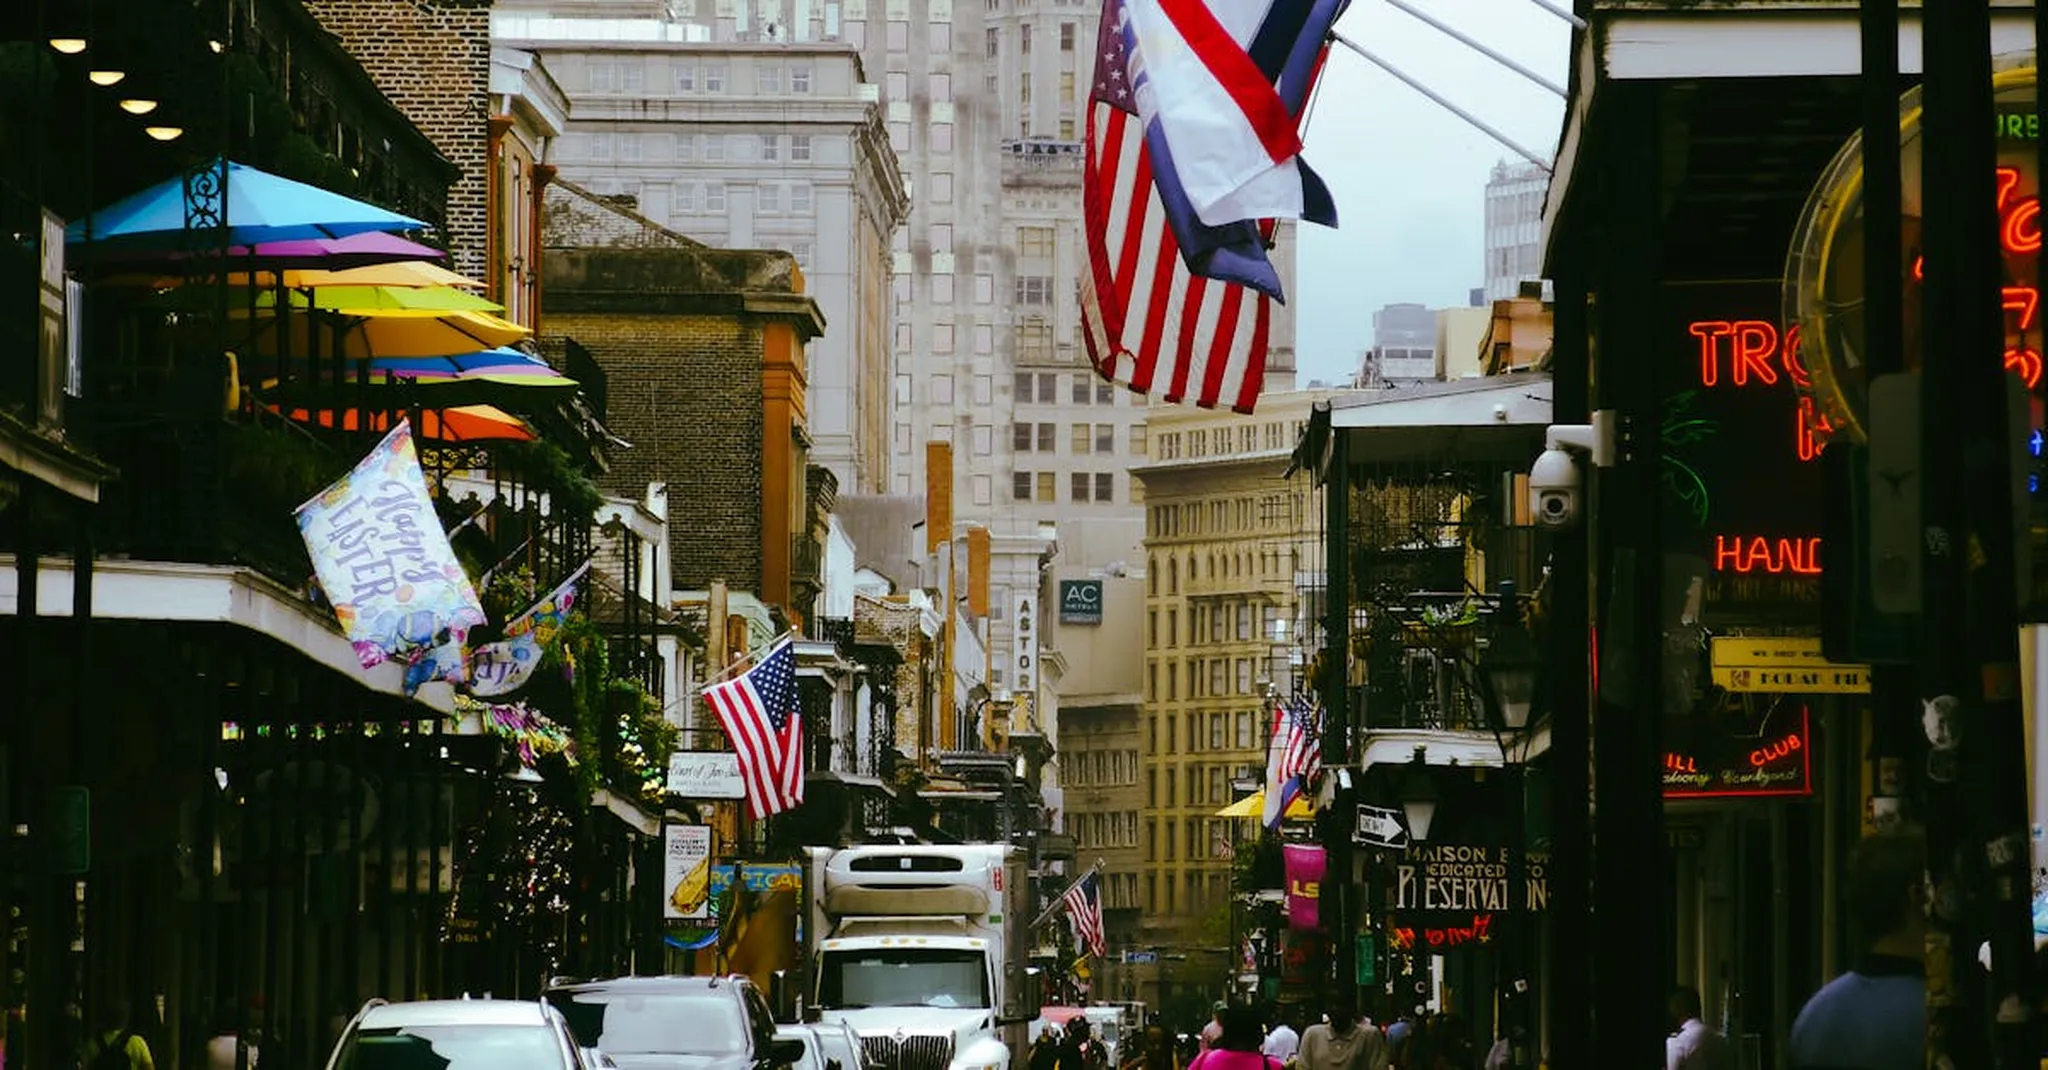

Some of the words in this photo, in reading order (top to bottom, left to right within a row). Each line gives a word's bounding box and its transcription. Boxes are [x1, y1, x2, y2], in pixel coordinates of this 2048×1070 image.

[371, 480, 450, 589] Happy
[327, 495, 398, 609] EASTER
[1066, 584, 1098, 603] AC
[1018, 599, 1031, 689] ASTOR
[1749, 736, 1802, 767] CLUB
[1404, 846, 1486, 863] MAISON
[710, 871, 802, 890] ROPICAL
[1425, 863, 1506, 877] EDICATED
[1525, 864, 1543, 877] O
